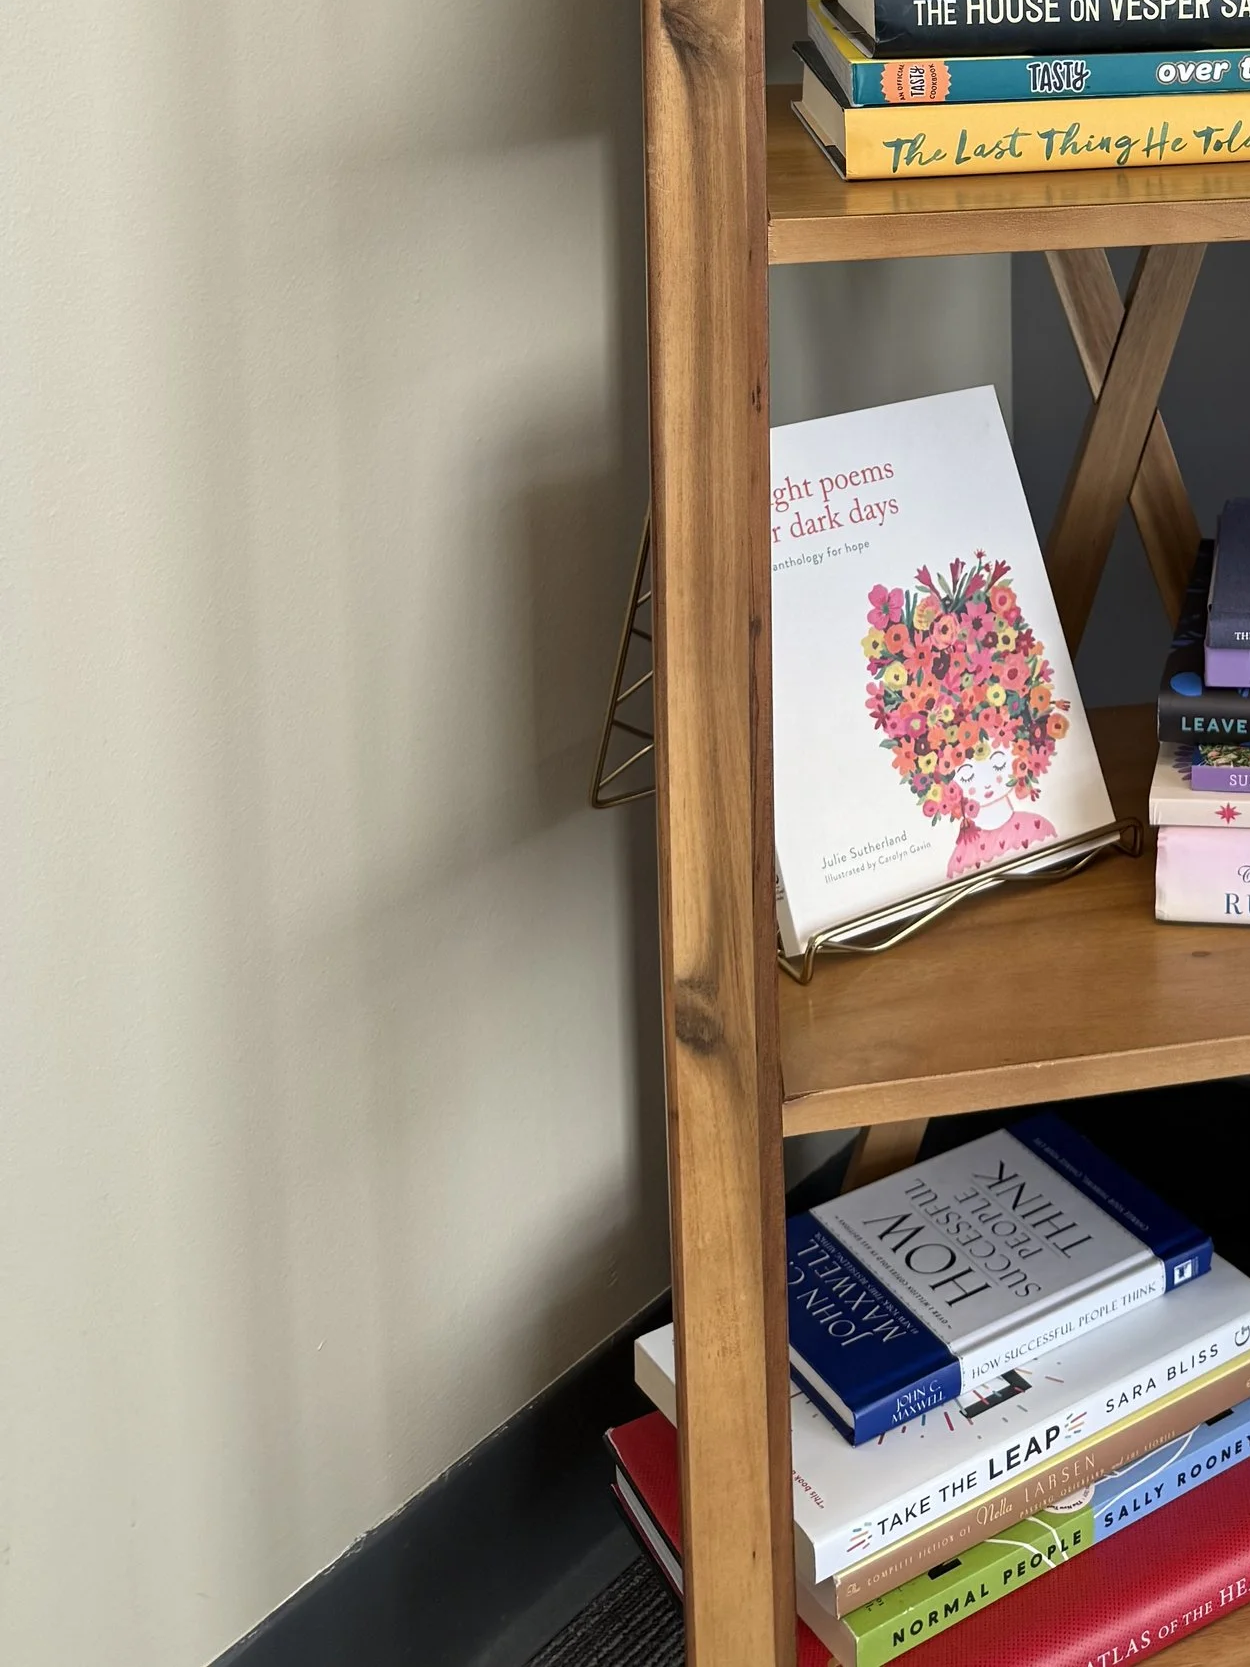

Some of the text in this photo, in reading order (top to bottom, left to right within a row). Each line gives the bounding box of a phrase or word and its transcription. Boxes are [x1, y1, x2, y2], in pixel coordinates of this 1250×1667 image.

[913, 0, 957, 26] THE
[910, 66, 925, 97] TASTY
[1027, 61, 1090, 93] TASTY
[1157, 59, 1229, 82] over
[883, 134, 946, 173] The
[955, 128, 1032, 165] Last
[1037, 123, 1140, 166] Thing
[1142, 122, 1187, 161] He
[819, 462, 894, 502] poems
[790, 498, 899, 538] dark days
[773, 541, 869, 572] anthology for hope
[1182, 717, 1247, 734] LEAVE
[822, 830, 907, 869] Julie Sutherland
[954, 1190, 1043, 1260] PEOPLE
[973, 1159, 1094, 1259] THINK
[904, 1178, 1042, 1299] SUCCESSFUL
[863, 1212, 992, 1308] HOW
[972, 1281, 1157, 1379] HOW SUCCESSFUL PEOPLE THINK
[878, 1496, 931, 1535] TAKE
[939, 1471, 977, 1502] THE
[989, 1425, 1060, 1480] LEAP
[1106, 1378, 1157, 1413] SARA
[1167, 1344, 1219, 1381] BLISS
[892, 1584, 990, 1646] NORMAL
[1003, 1529, 1082, 1585] PEOPLE
[1104, 1483, 1165, 1527] SALLY
[1159, 1619, 1178, 1639] OF
[1183, 1602, 1213, 1627] THE
